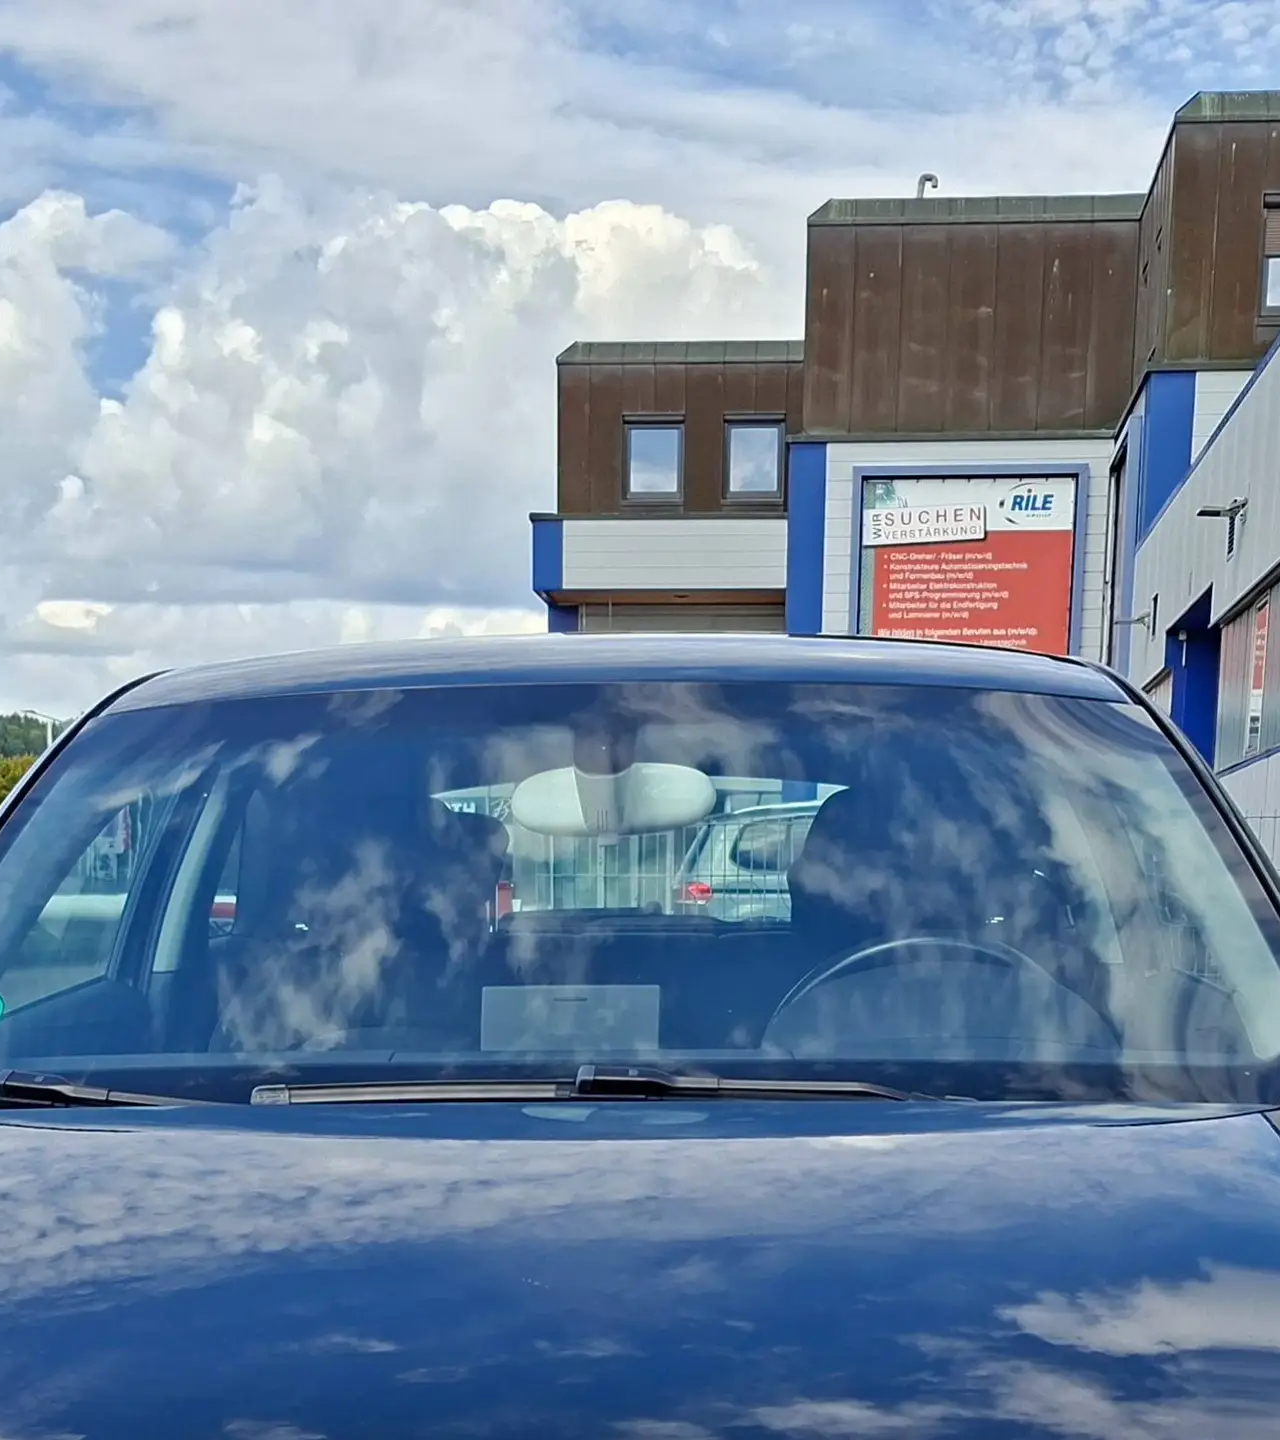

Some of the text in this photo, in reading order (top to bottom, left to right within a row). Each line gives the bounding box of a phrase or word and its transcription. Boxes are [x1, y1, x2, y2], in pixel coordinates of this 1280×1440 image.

[872, 513, 882, 540] WIR
[884, 507, 981, 527] SUCHEN
[884, 525, 982, 540] VERSTÄRKUNG!
